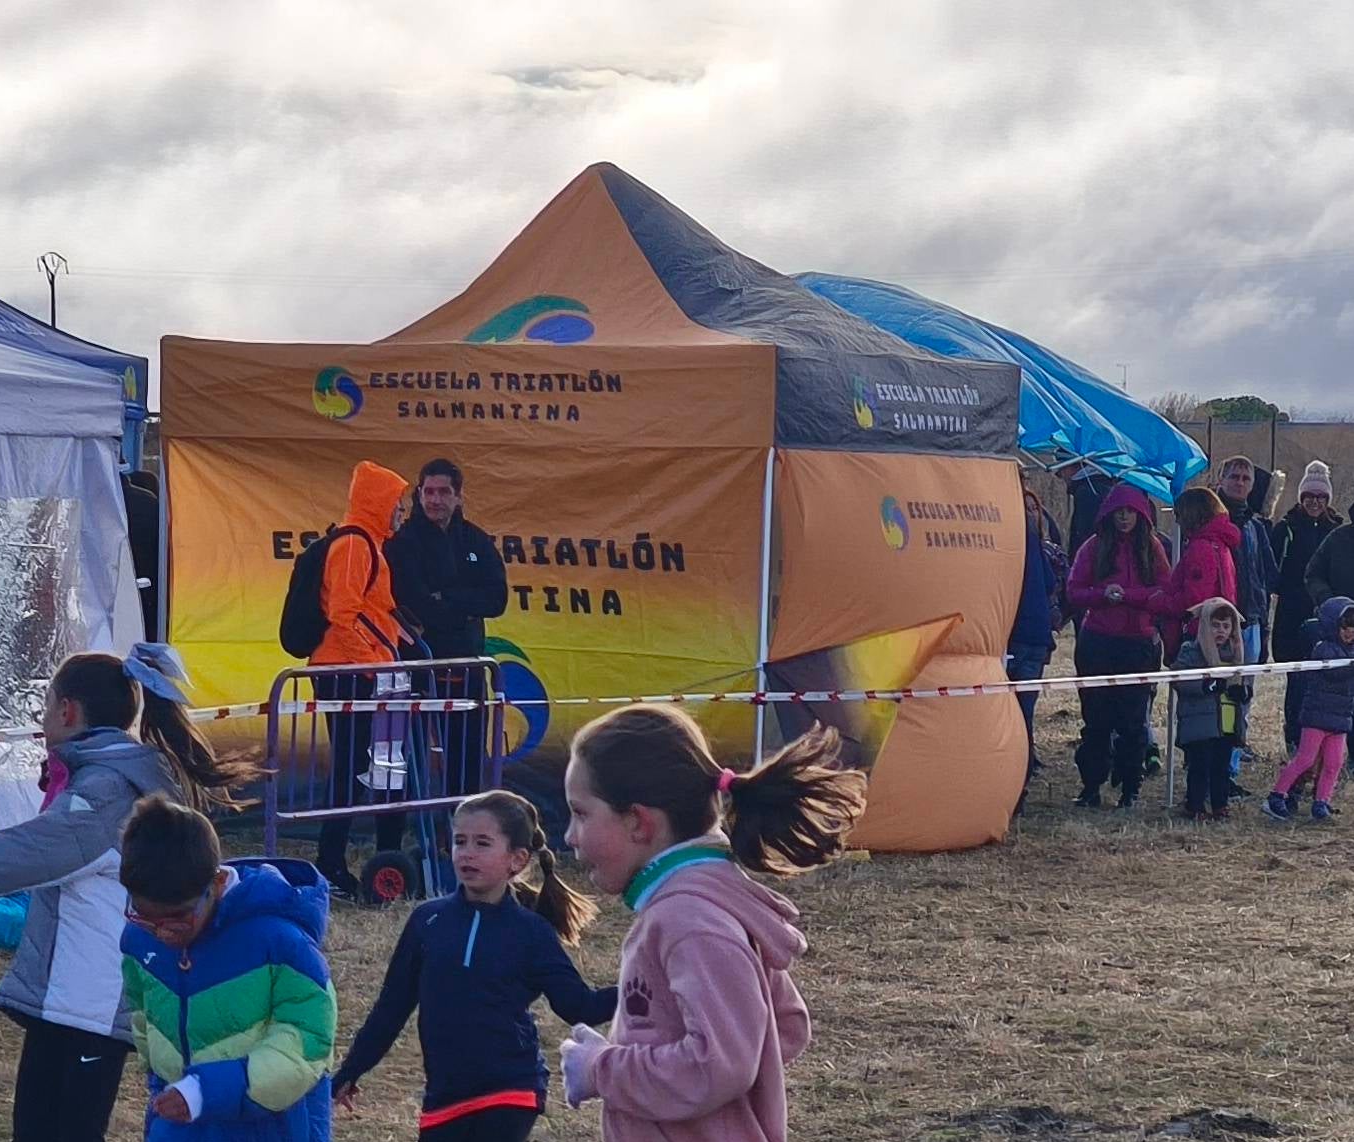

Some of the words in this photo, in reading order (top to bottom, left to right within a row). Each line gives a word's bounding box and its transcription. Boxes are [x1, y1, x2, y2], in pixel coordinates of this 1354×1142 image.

[369, 371, 481, 389] ESCUELA
[490, 369, 622, 392] TRIATLÓN
[875, 383, 926, 402] ESCUELA
[924, 384, 981, 405] TRIATLÓN
[398, 401, 580, 421] SALMANTINA
[893, 413, 968, 432] SALMANTINA
[907, 501, 957, 520] ESCUELA
[925, 531, 997, 551] SALMANTINA
[488, 533, 685, 571] RIATLÓN
[512, 585, 622, 615] TINA
